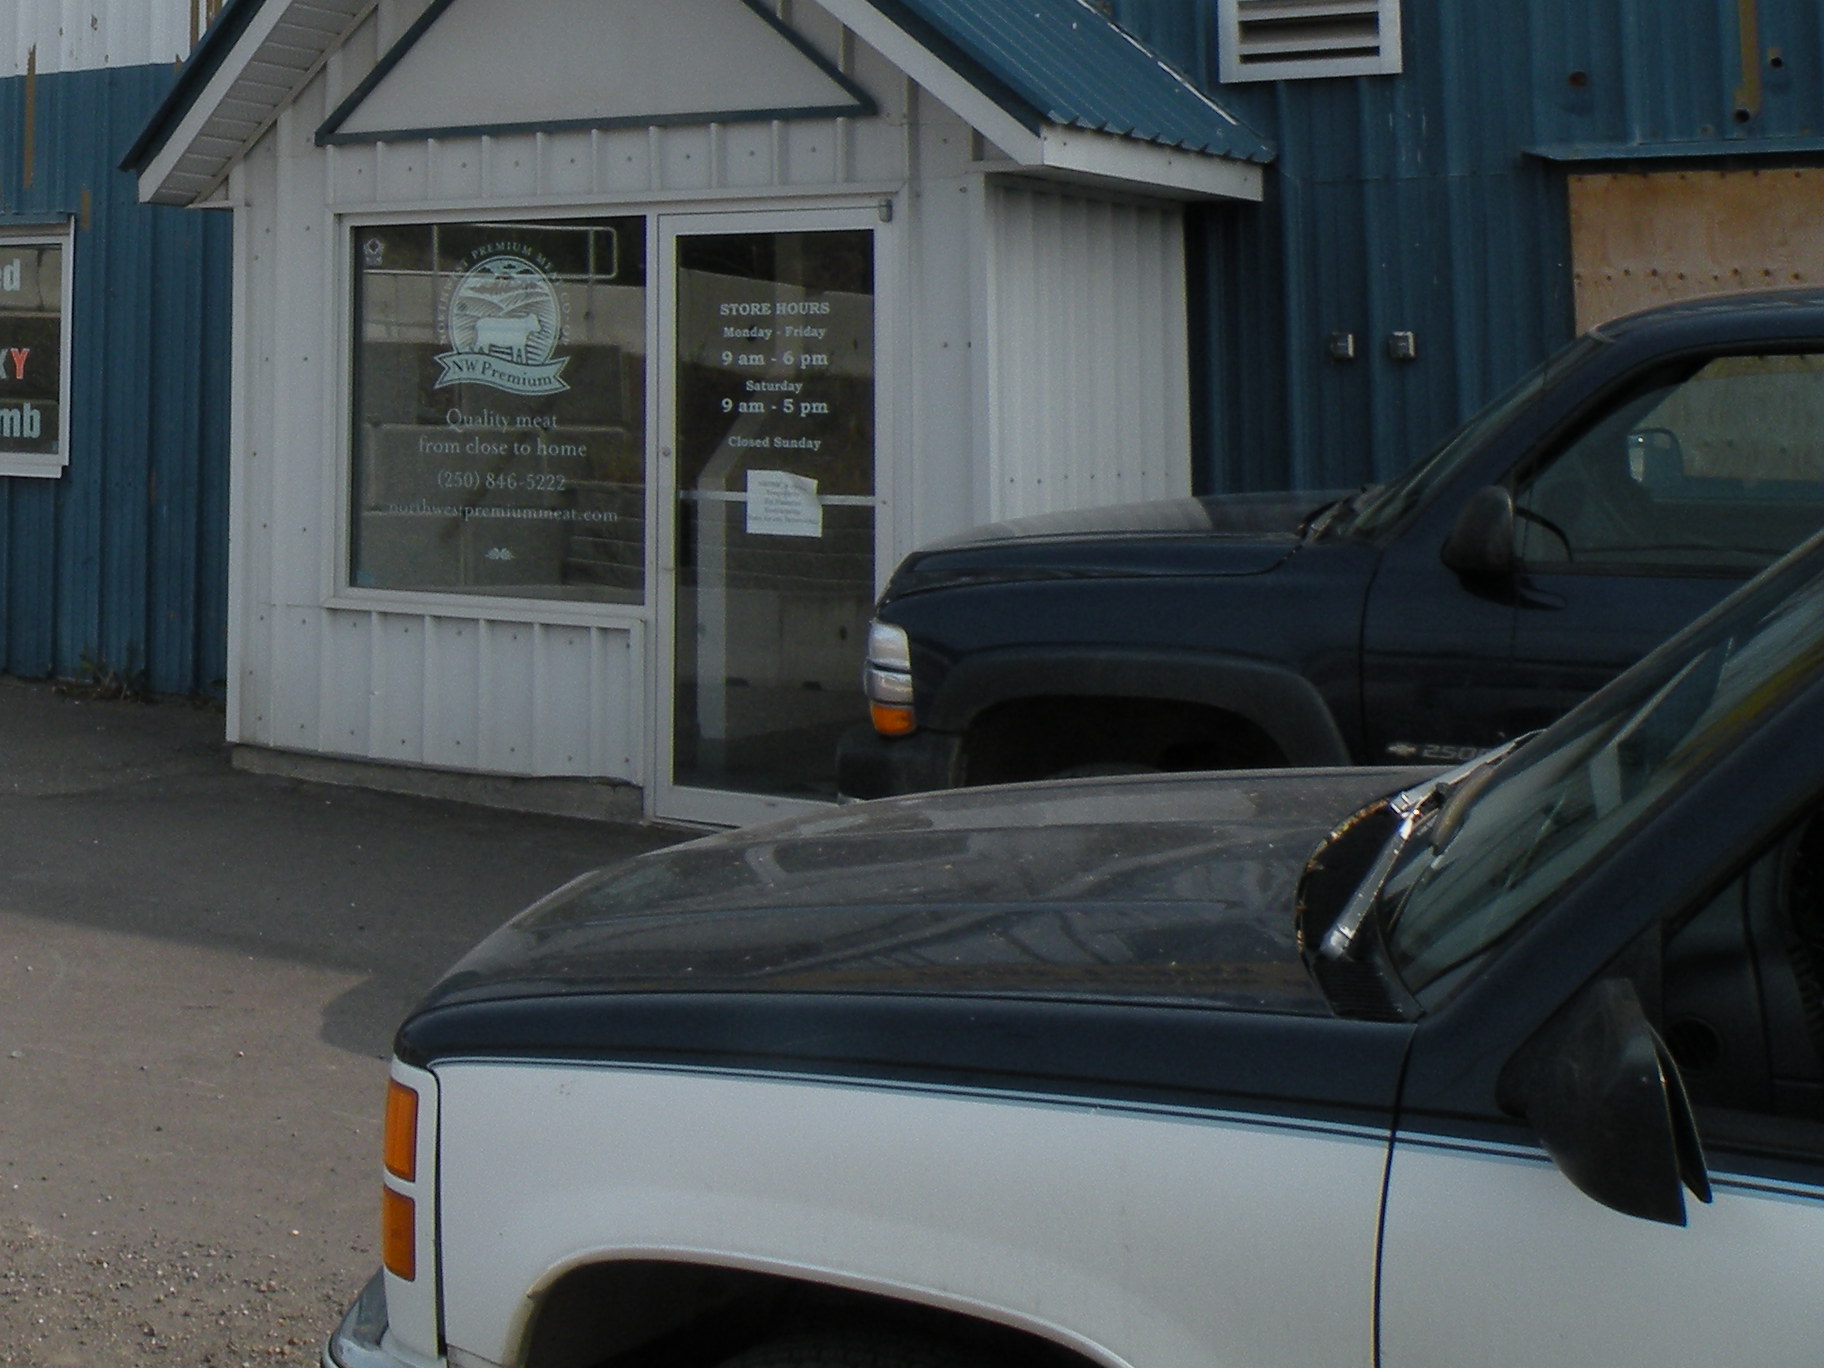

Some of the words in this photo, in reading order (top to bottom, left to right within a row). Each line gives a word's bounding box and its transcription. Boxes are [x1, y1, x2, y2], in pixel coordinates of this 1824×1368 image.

[719, 302, 772, 316] STORE
[776, 301, 831, 315] HOURS
[723, 326, 773, 339] Monday
[784, 325, 827, 340] Friday
[721, 351, 733, 366] 9
[738, 354, 765, 366] am
[782, 351, 795, 366] 6
[799, 354, 829, 369] pm
[451, 358, 477, 374] NW
[481, 360, 553, 388] Premium
[745, 380, 804, 394] Saturday
[721, 398, 733, 413] 9
[738, 401, 765, 413] am
[782, 398, 795, 413] 5
[799, 401, 829, 417] pm
[445, 407, 511, 433] Quality
[515, 414, 558, 429] meat
[418, 436, 460, 454] from
[465, 436, 509, 455] close
[513, 440, 531, 455] to
[536, 437, 588, 457] home
[727, 435, 770, 449] Closed
[773, 436, 822, 451] Sunday
[437, 470, 480, 489] (250)
[485, 471, 567, 492] 846-5222
